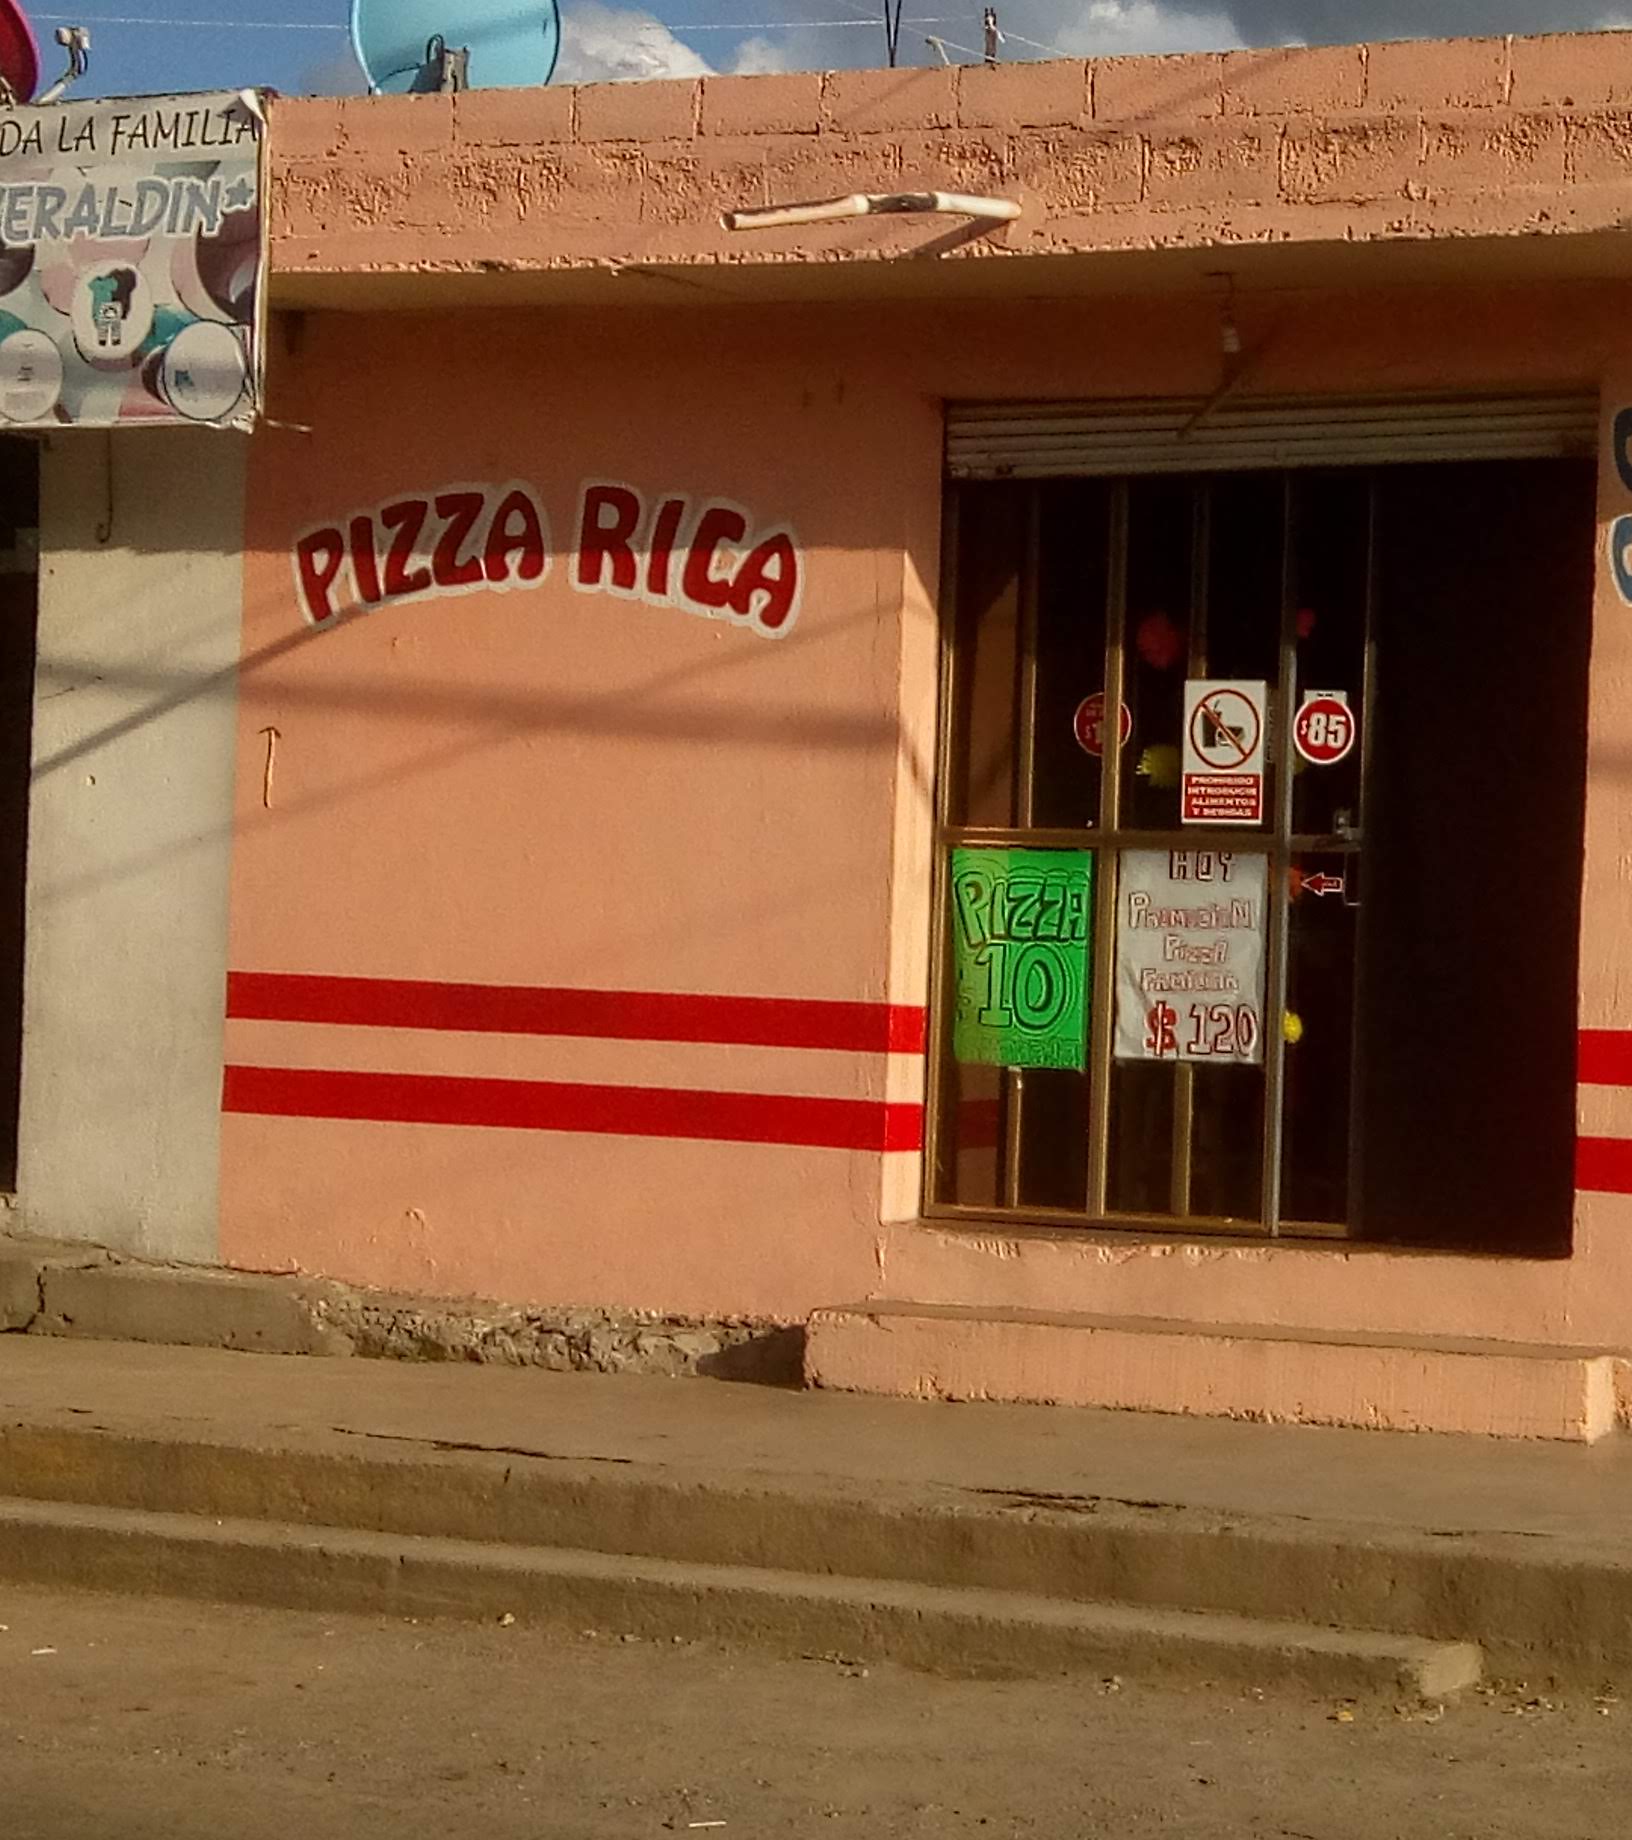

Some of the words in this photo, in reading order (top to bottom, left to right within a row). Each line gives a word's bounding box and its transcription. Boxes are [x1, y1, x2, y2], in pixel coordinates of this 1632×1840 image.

[58, 114, 96, 153] LA
[110, 108, 258, 156] FAMILIA
[0, 180, 222, 240] ERALDIN
[296, 487, 547, 626] PIZZA
[576, 483, 799, 630] RICA
[1300, 711, 1347, 750] $85
[1168, 850, 1234, 882] HOY
[954, 871, 1088, 950] PIZZA
